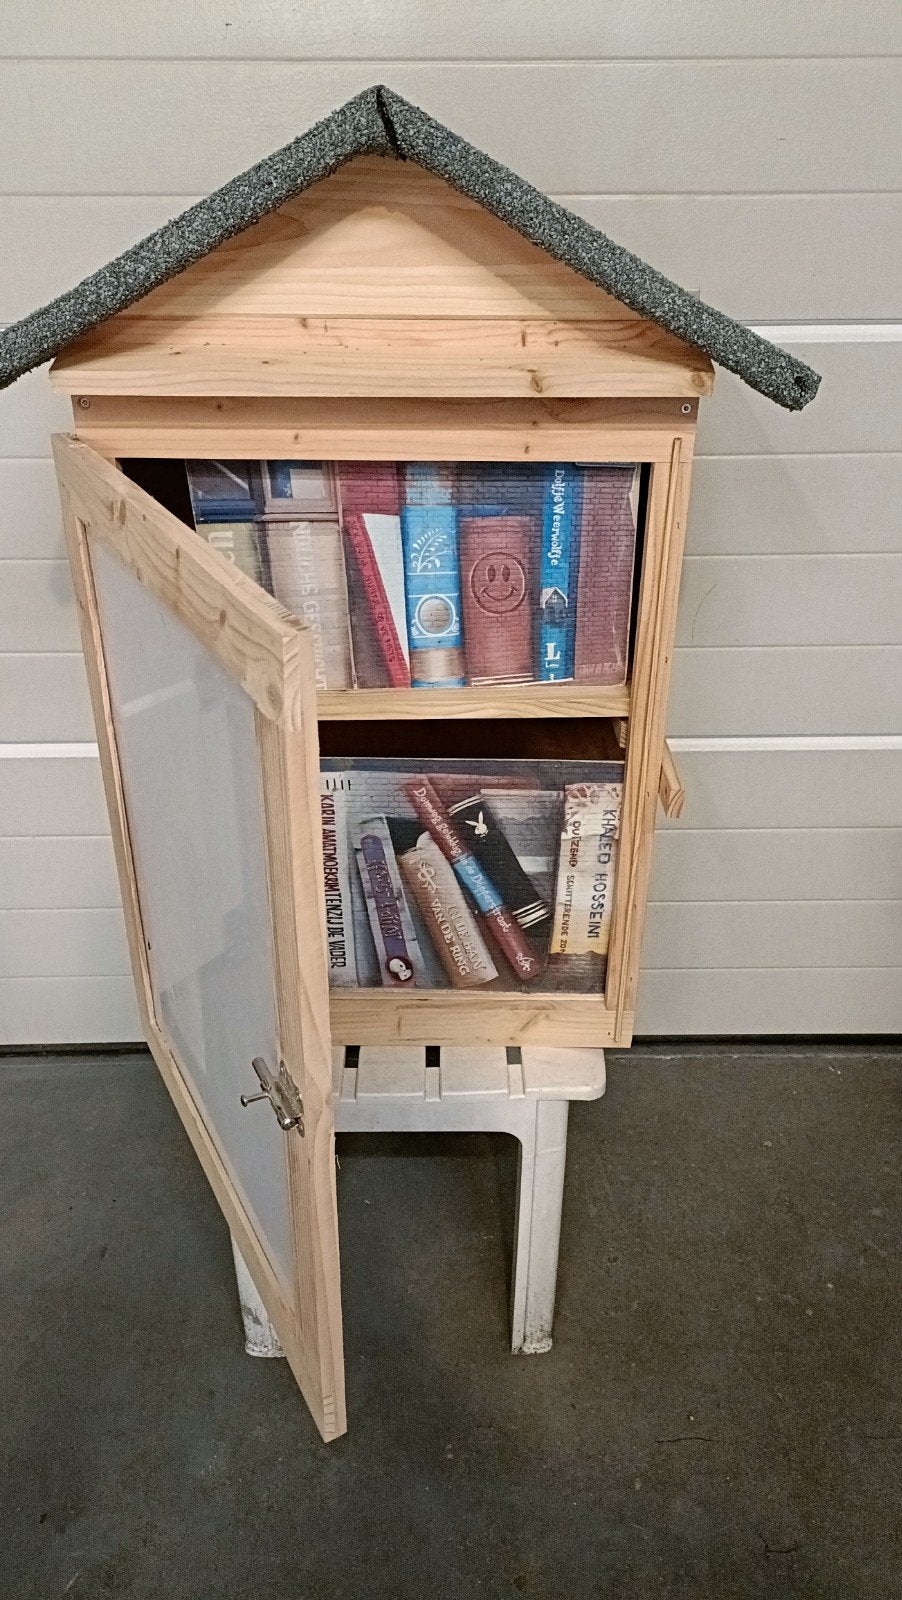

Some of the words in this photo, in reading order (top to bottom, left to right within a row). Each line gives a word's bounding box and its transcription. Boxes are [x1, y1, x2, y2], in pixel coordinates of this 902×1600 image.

[320, 794, 336, 826] KARIN
[597, 809, 618, 865] KHALED
[324, 892, 344, 925] TENZIJ
[586, 873, 609, 939] HOSSEINI
[327, 927, 345, 938] DE
[430, 898, 448, 924] VAN
[440, 924, 456, 944] DE
[449, 944, 471, 976] RING
[328, 940, 347, 969] VADER
